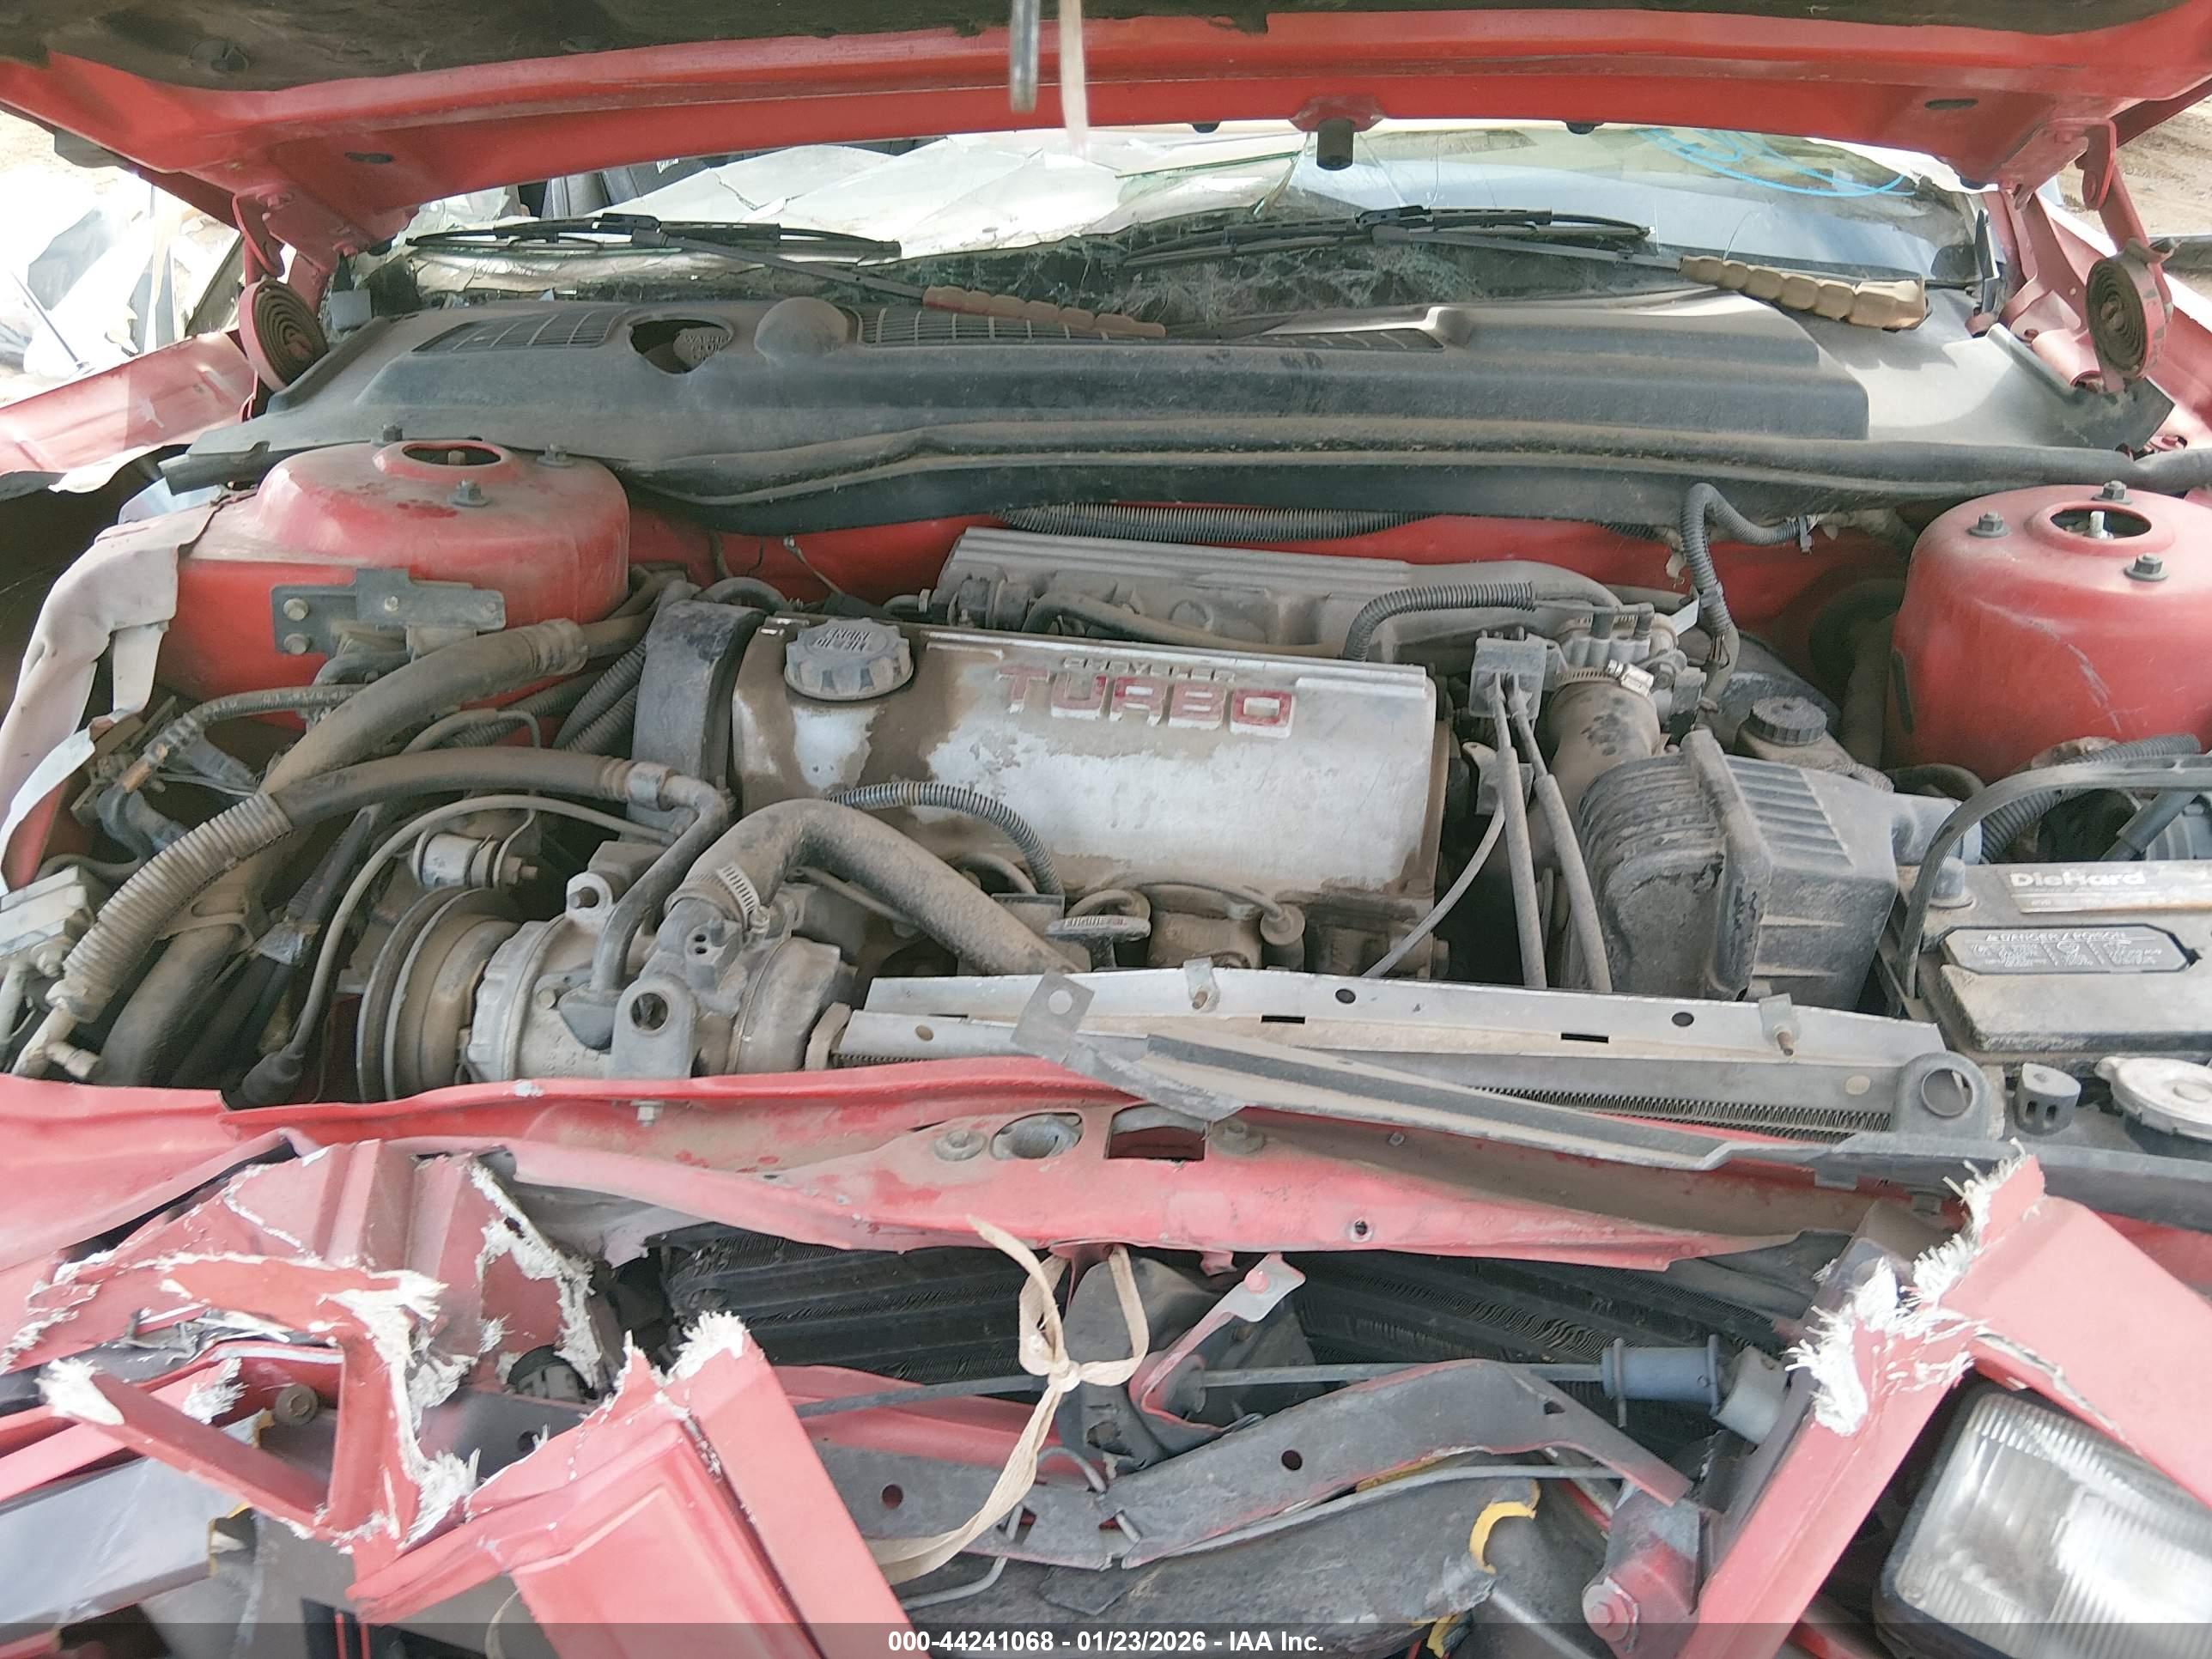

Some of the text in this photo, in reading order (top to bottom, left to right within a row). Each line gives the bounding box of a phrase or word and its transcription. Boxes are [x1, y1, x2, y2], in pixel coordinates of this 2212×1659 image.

[1062, 657, 1237, 684] CHRYSLER
[996, 665, 1296, 739] TURBO
[2010, 870, 2146, 887] DieHard
[1064, 915, 1105, 928] ENGINE
